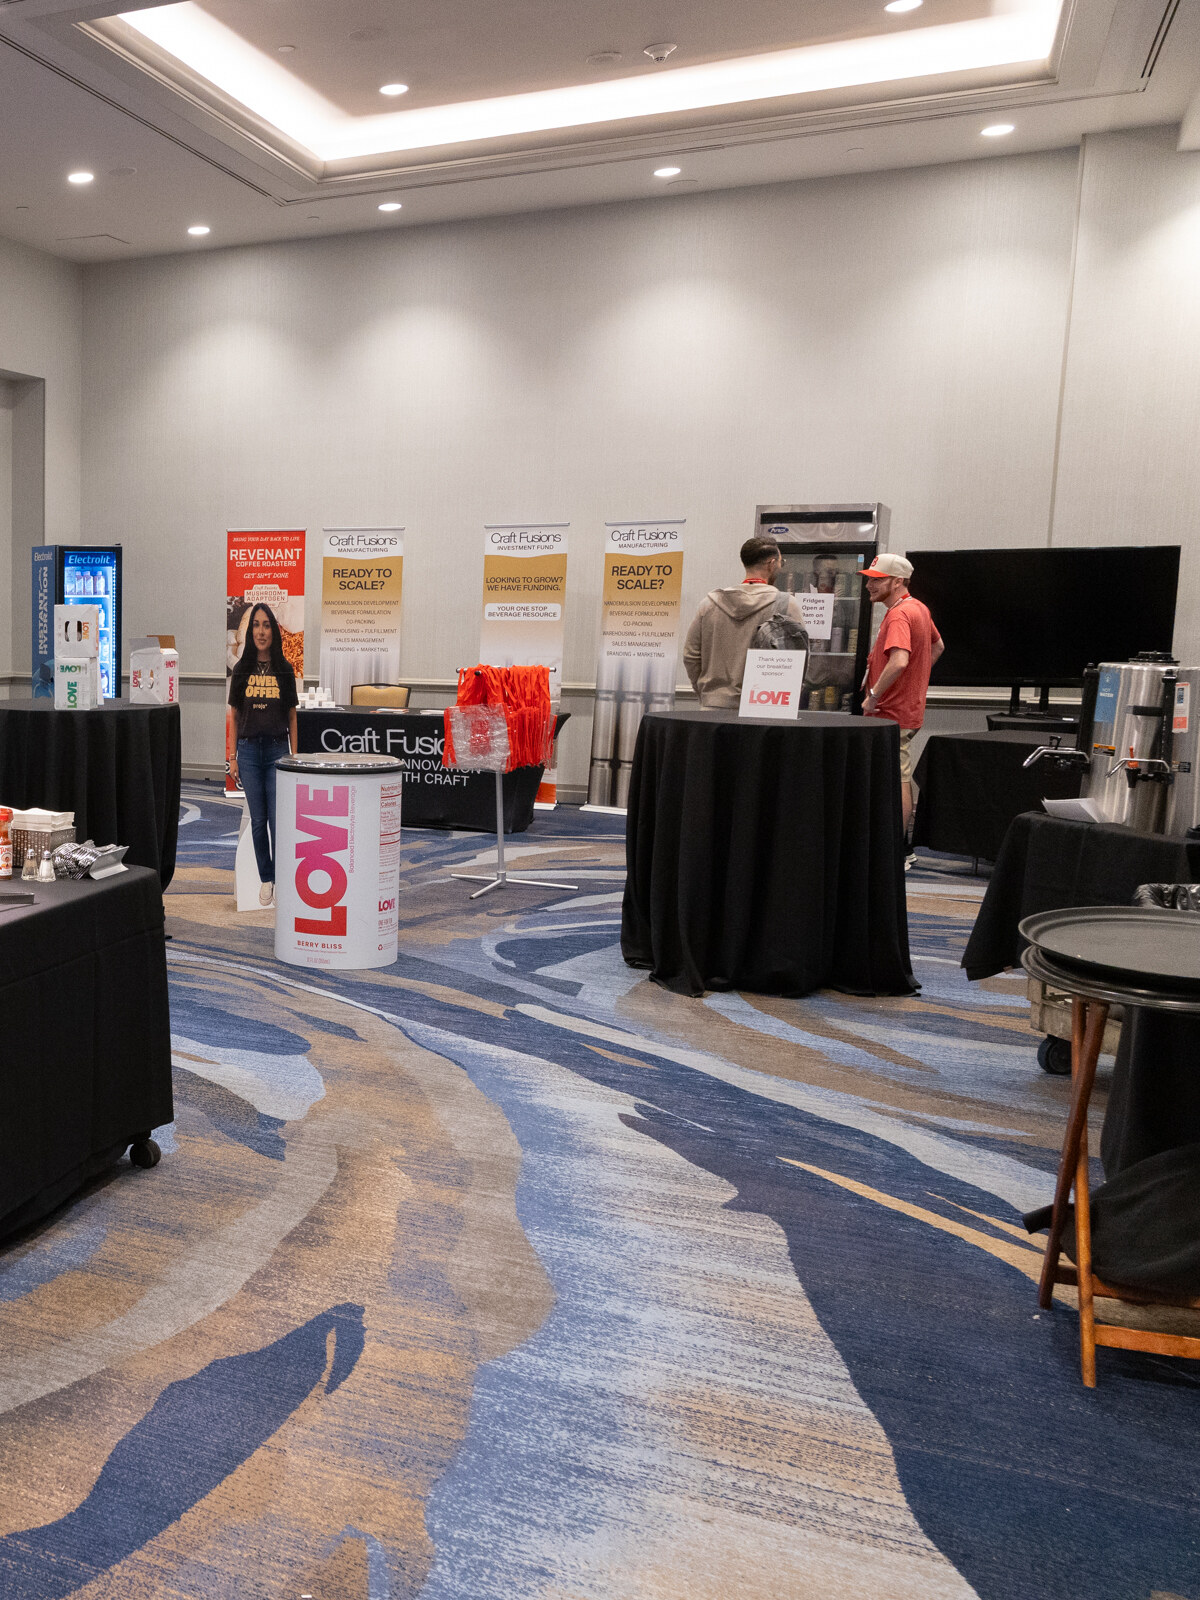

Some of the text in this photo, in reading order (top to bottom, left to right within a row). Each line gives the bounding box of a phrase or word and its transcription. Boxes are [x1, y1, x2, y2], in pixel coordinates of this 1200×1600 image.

[329, 534, 398, 547] Craft Fusions
[490, 531, 562, 544] Craft Fusions
[611, 528, 678, 542] Craft Fusions
[34, 551, 53, 562] Electrolit
[68, 554, 111, 564] Electrolit
[230, 548, 302, 560] REVENANT
[332, 568, 393, 578] READY TO
[611, 565, 672, 577] READY TO
[338, 580, 385, 591] SCALE?
[617, 579, 665, 590] SCALE?
[60, 664, 82, 673] LOVE
[67, 681, 77, 709] LOVE
[245, 685, 280, 699] OFFER
[749, 689, 791, 706] LOVE
[320, 727, 445, 755] Craft Fusi
[402, 771, 470, 787] TH CRAFT
[294, 784, 349, 937] LOVE
[378, 898, 395, 912] LOVE
[297, 940, 319, 948] BERRY
